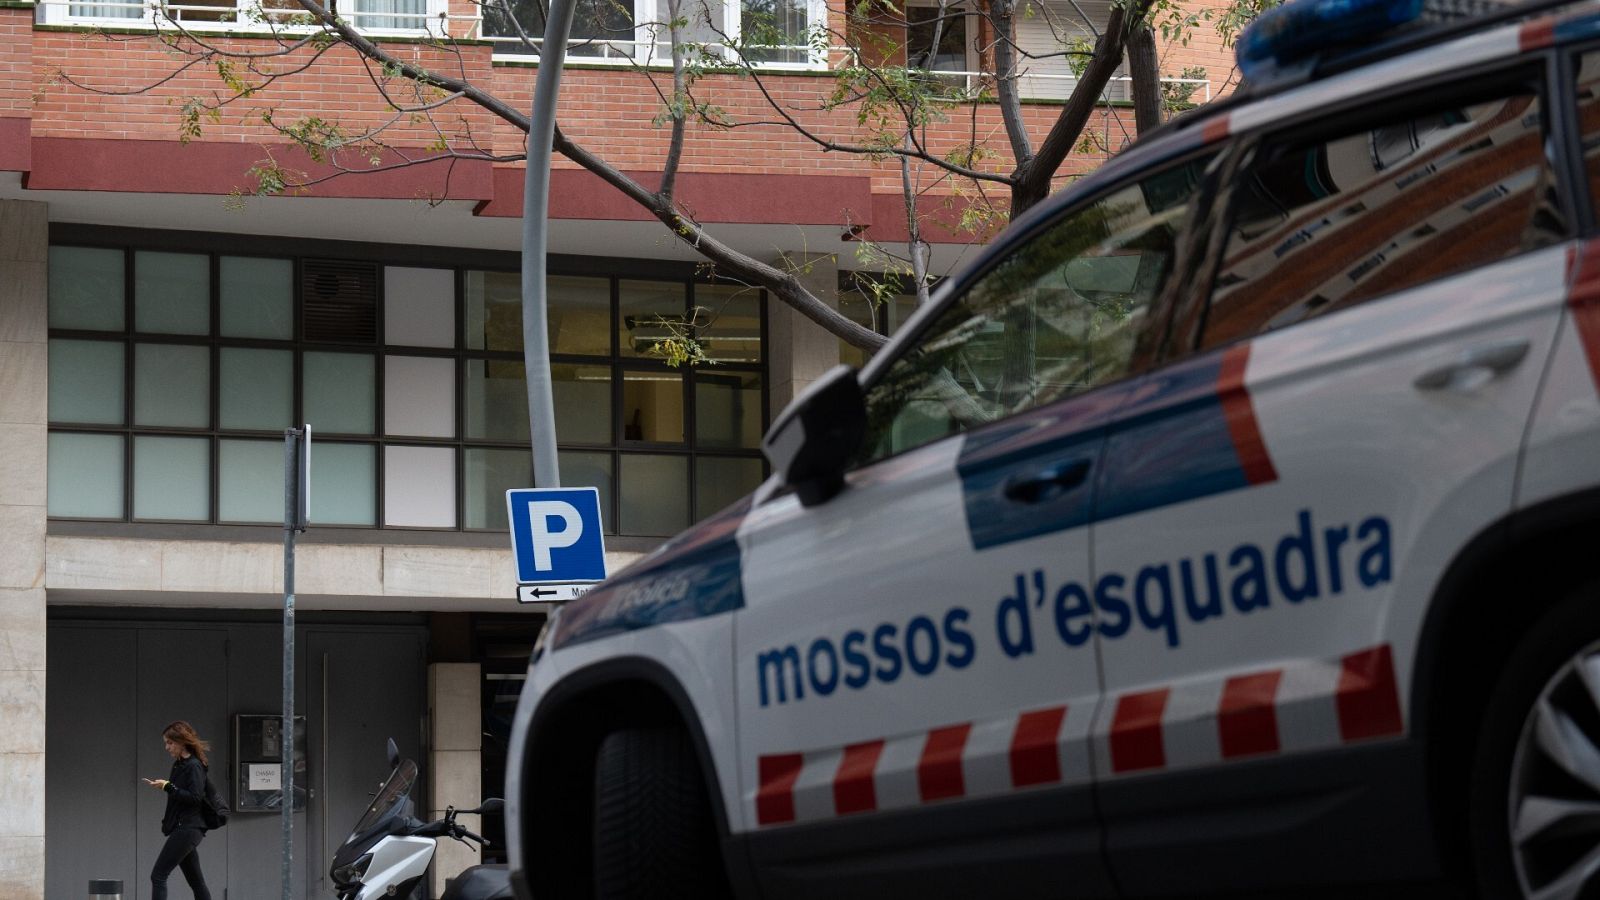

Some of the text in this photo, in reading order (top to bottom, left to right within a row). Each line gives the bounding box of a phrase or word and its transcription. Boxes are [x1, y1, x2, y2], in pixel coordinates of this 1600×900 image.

[527, 500, 584, 571] P
[756, 509, 1393, 708] mossos d'esquadra
